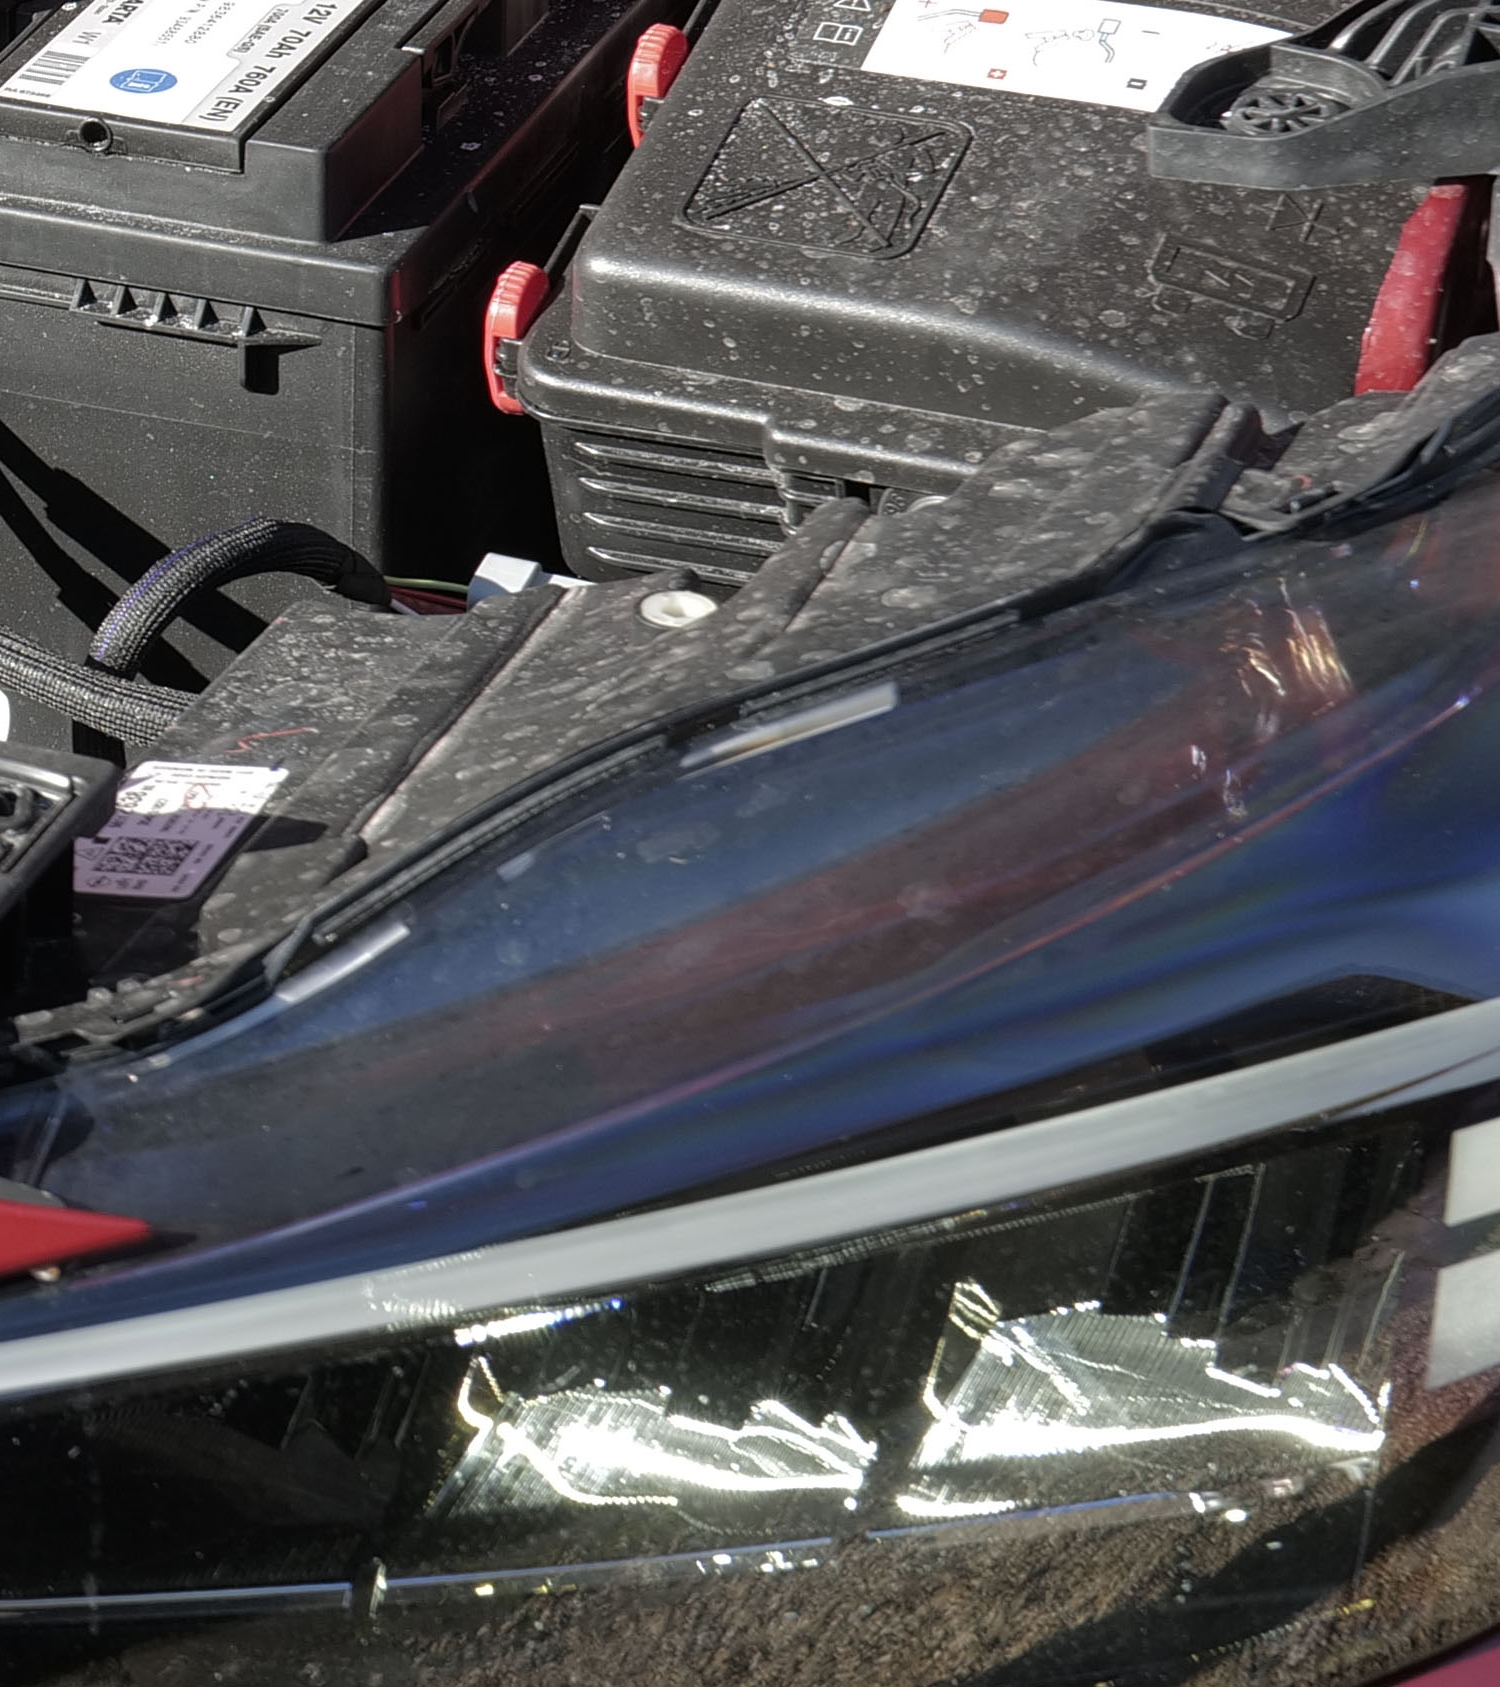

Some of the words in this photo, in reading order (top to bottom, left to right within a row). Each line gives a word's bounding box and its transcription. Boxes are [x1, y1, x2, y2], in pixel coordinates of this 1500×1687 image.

[302, 3, 338, 25] 12V
[265, 29, 313, 59] 70Ah
[227, 65, 277, 94] 760A
[198, 96, 244, 122] (EN)
